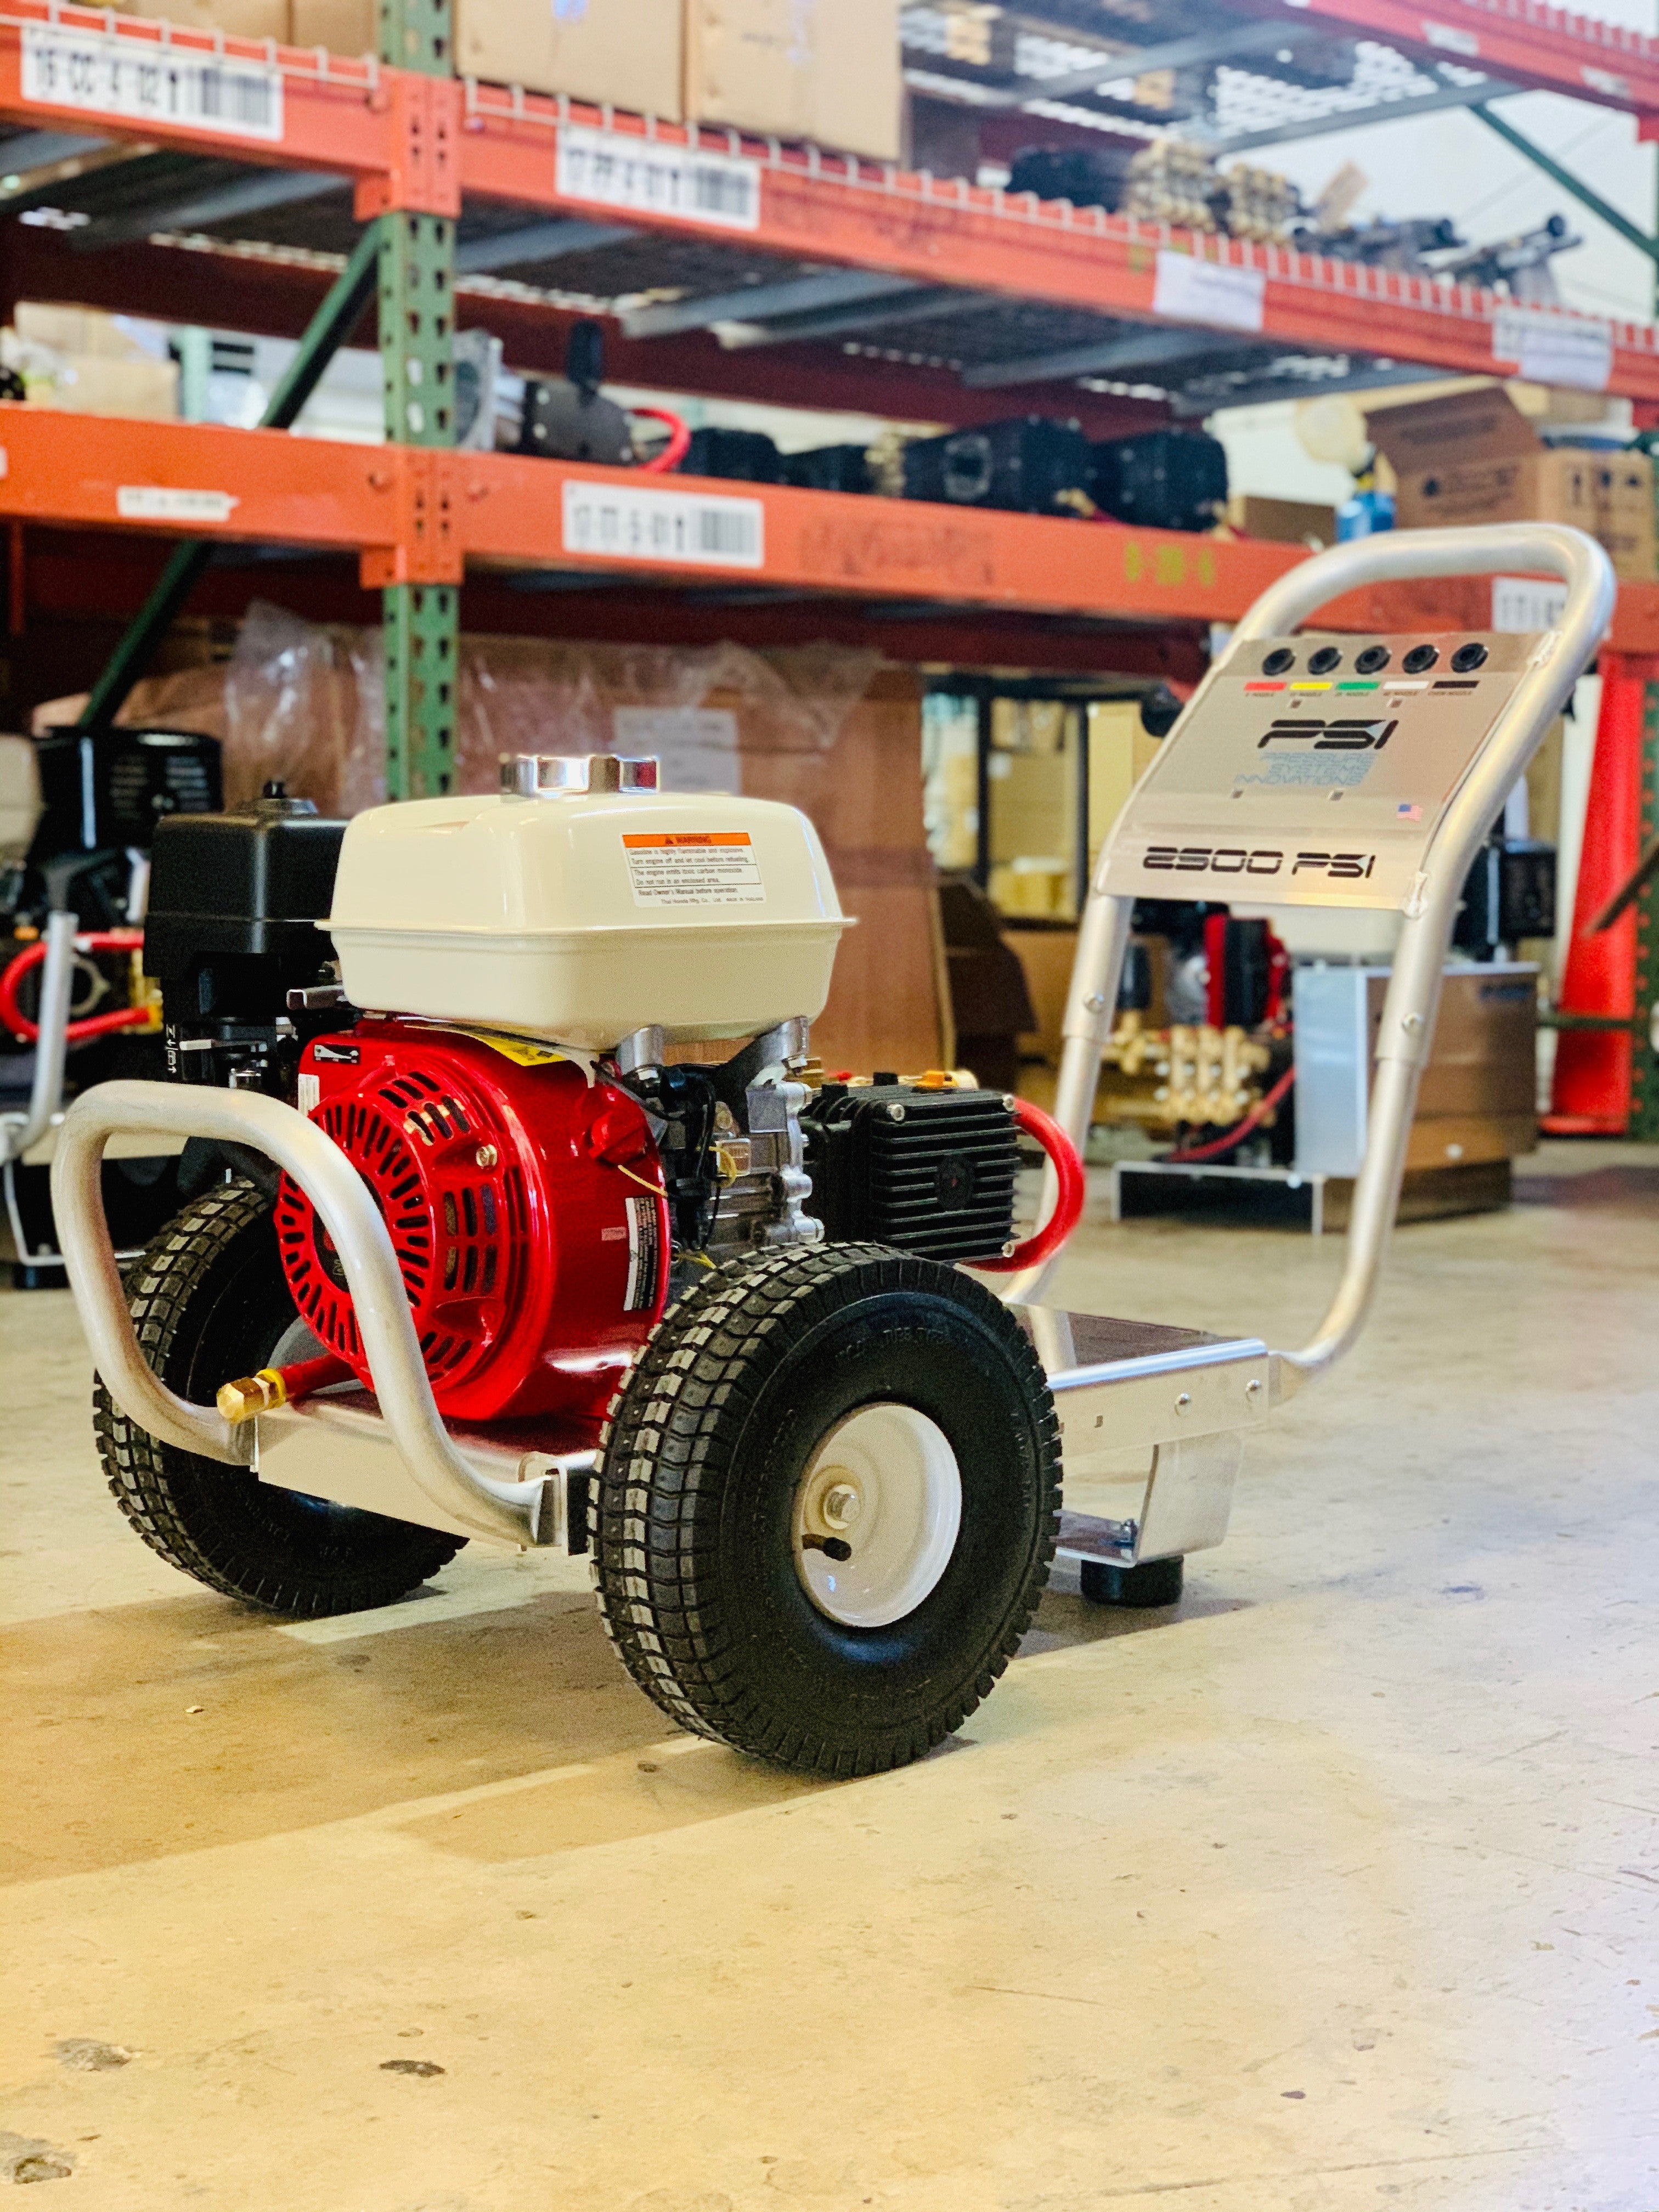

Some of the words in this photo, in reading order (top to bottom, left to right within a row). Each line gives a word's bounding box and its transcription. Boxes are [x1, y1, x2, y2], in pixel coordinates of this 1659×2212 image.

[1257, 719, 1399, 750] PSI
[1143, 847, 1284, 874] 2500
[1292, 852, 1376, 878] PSI
